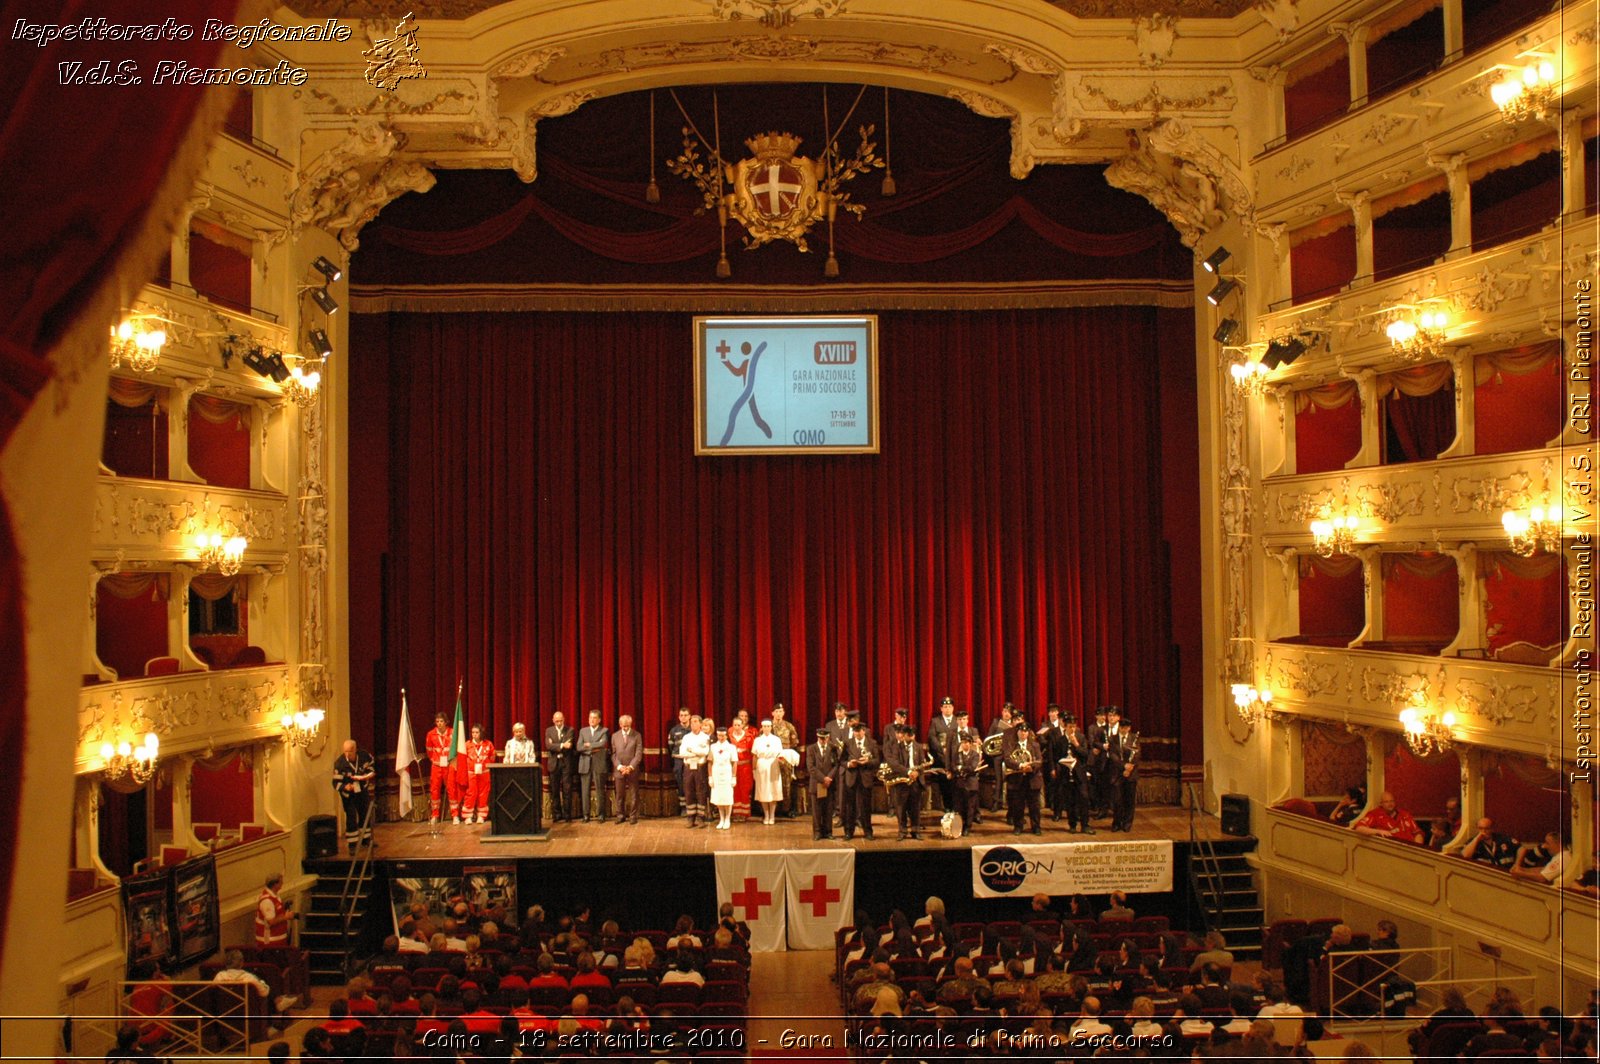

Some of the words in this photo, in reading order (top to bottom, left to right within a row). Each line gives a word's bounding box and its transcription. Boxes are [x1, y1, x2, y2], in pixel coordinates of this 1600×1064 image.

[793, 369, 813, 381] GARA
[815, 369, 856, 381] NAZIONALE
[793, 382, 817, 394] PRIMO
[819, 382, 857, 394] SOCCORSO
[831, 410, 856, 419] 17-18-19
[830, 420, 856, 428] SETTEMBRE
[793, 429, 826, 446] COMO
[980, 860, 1054, 876] ORION
